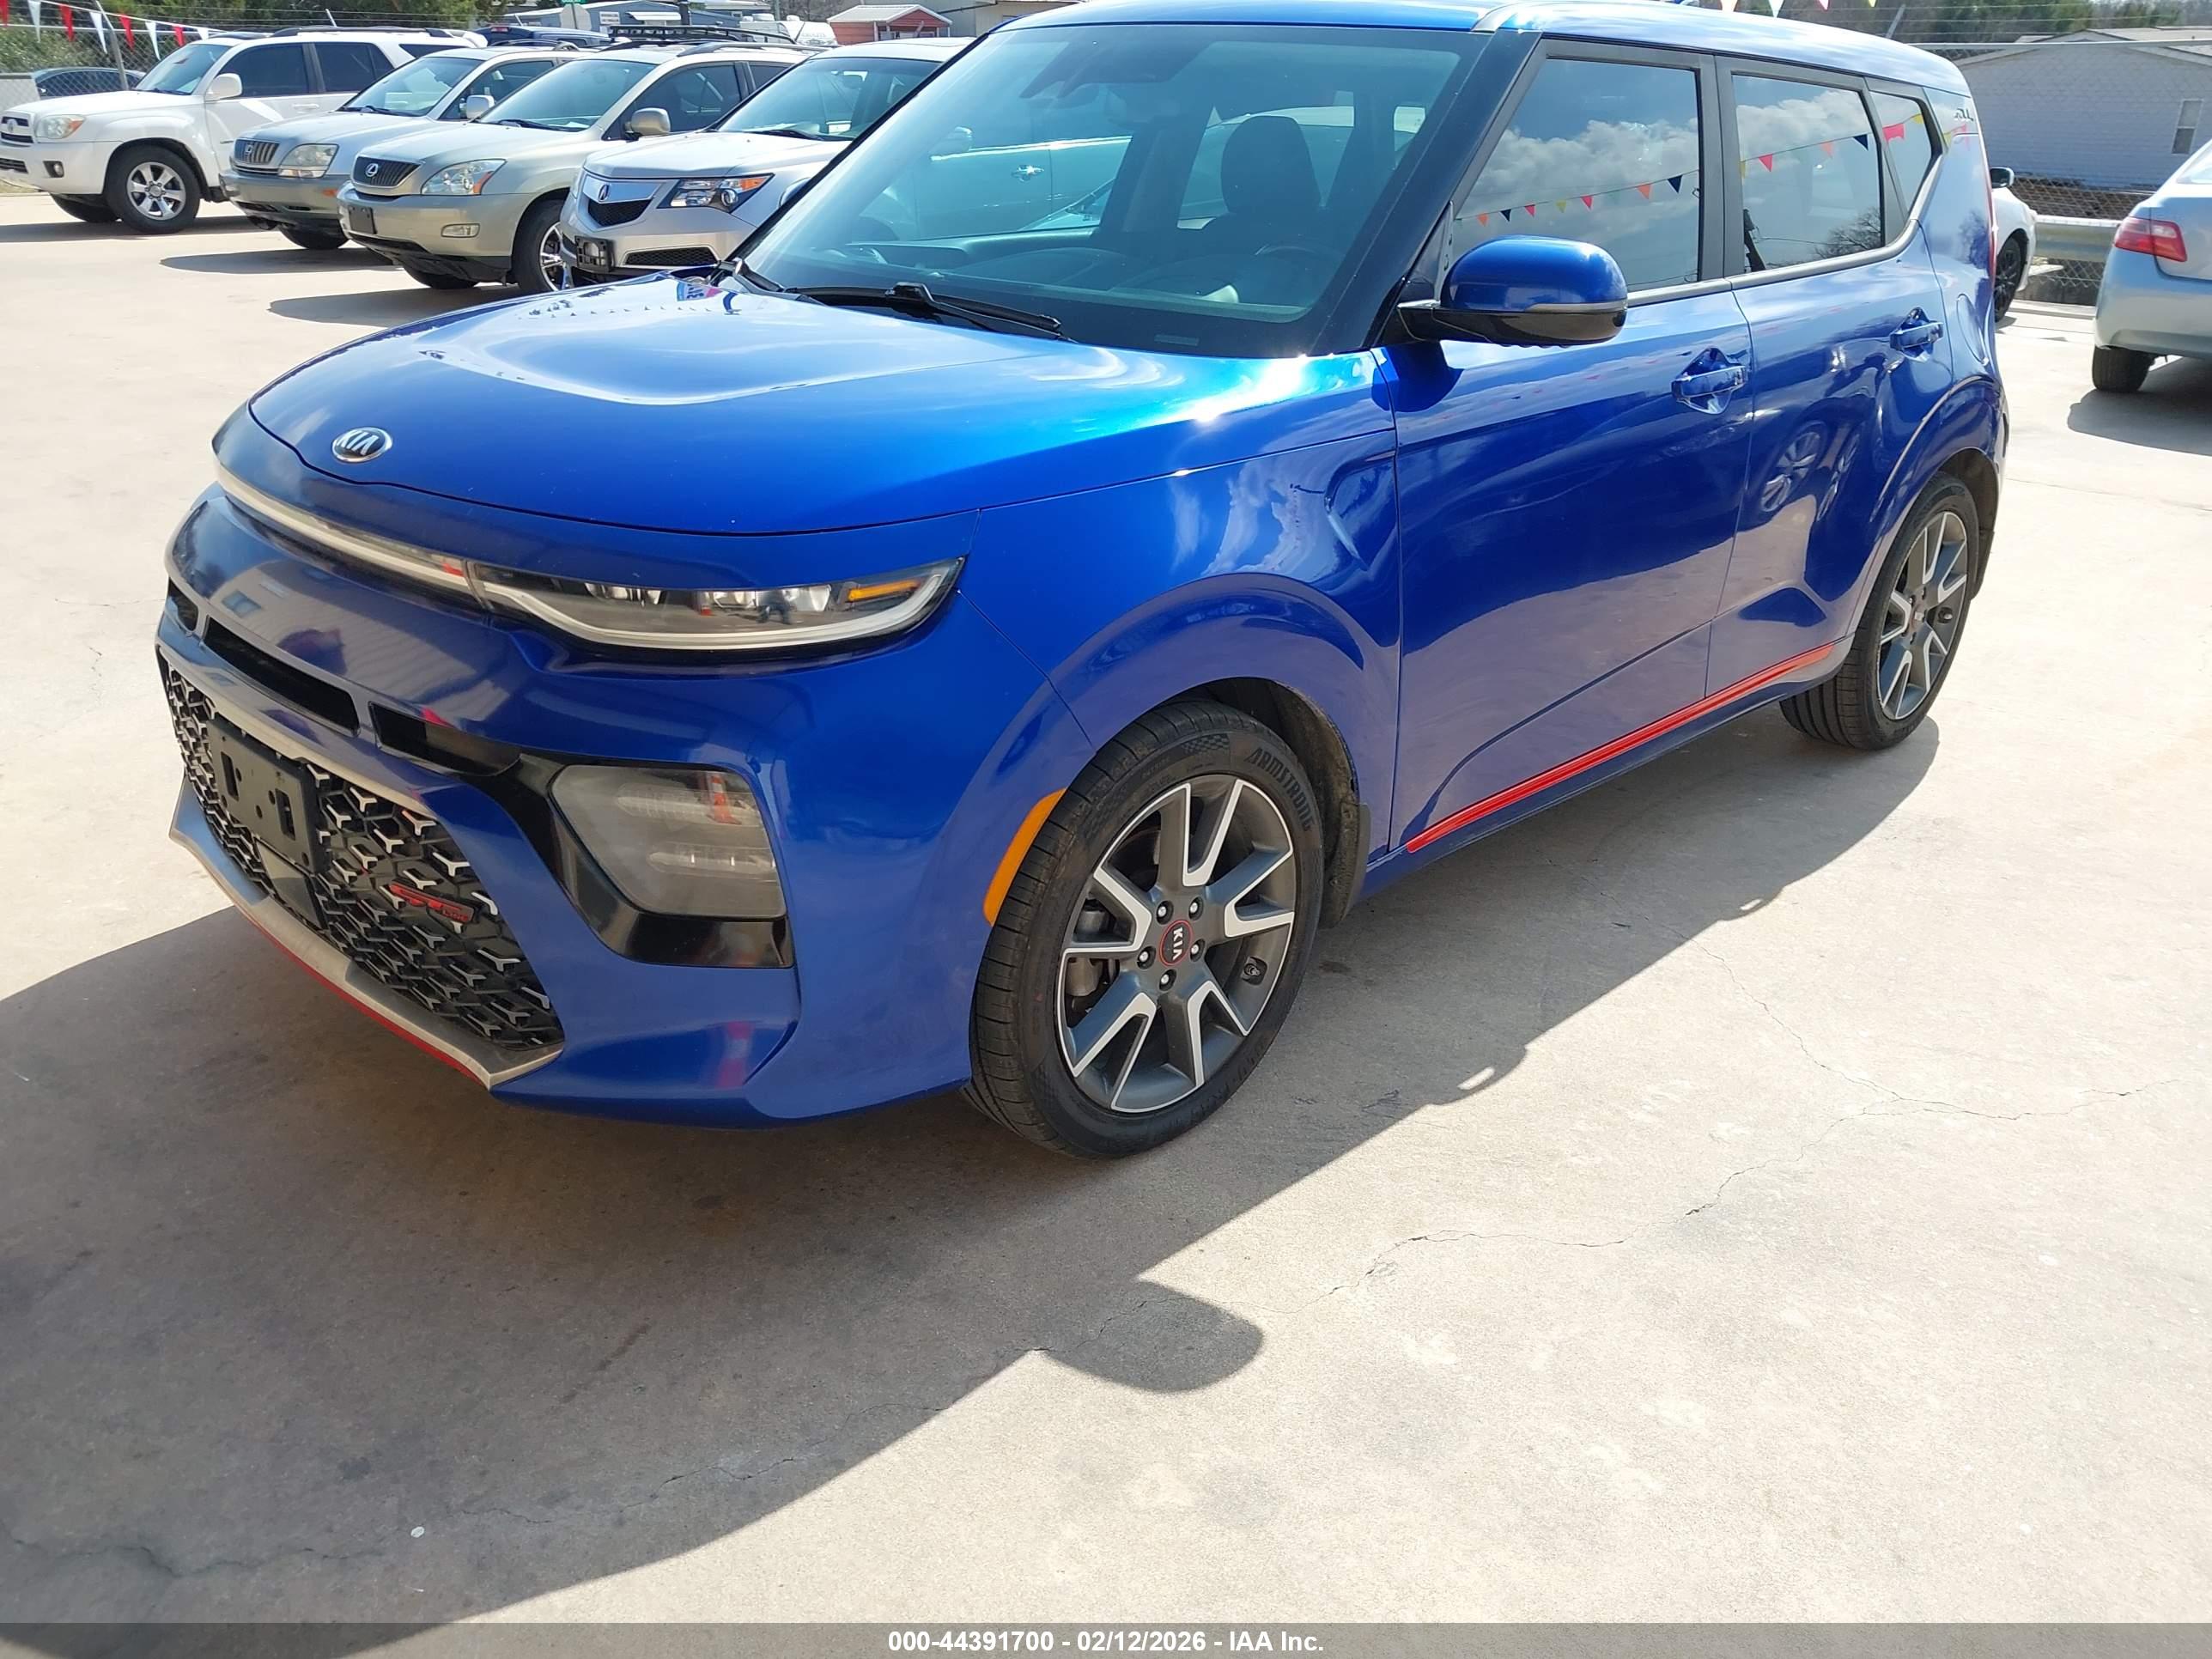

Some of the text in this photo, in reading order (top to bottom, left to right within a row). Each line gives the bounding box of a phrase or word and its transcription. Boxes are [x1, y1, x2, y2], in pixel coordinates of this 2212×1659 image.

[336, 429, 380, 456] KIA
[1246, 745, 1315, 831] ARMSTRONG
[1172, 927, 1183, 961] KIA
